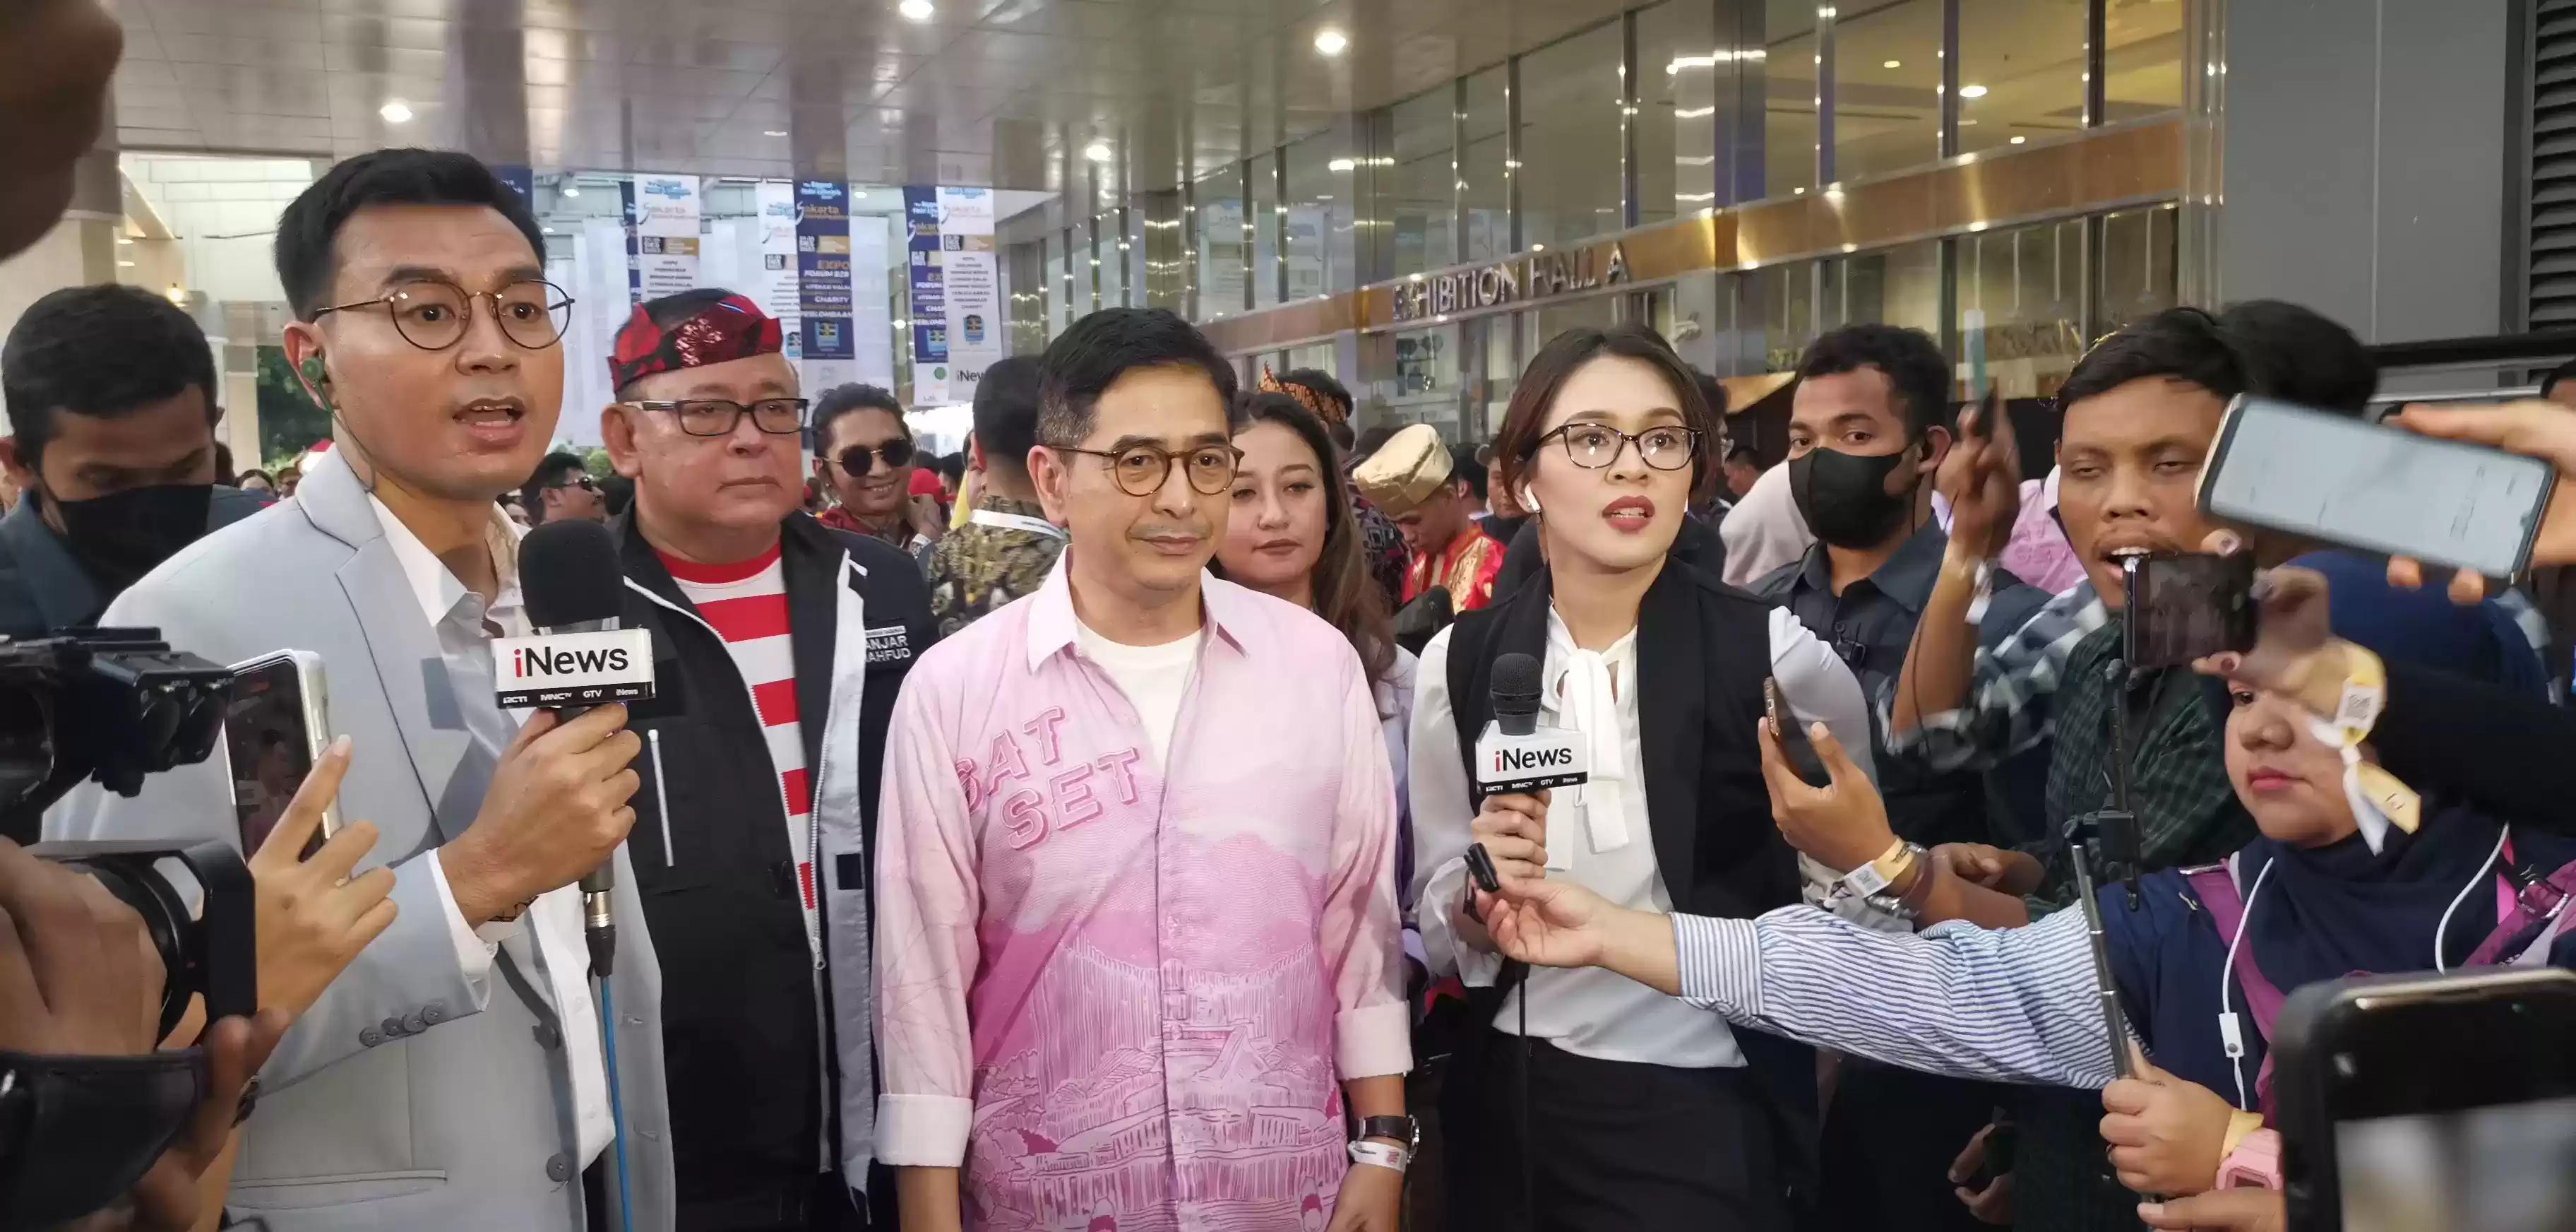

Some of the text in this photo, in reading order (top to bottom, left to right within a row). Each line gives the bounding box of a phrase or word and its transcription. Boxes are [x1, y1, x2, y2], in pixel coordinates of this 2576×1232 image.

[1530, 246, 1597, 296] HALL
[1607, 241, 1629, 283] A
[866, 635, 909, 650] ANJAR
[514, 646, 628, 677] iNews
[583, 689, 602, 698] GTV
[1495, 748, 1573, 772] iNews
[1001, 747, 1143, 851] SET
